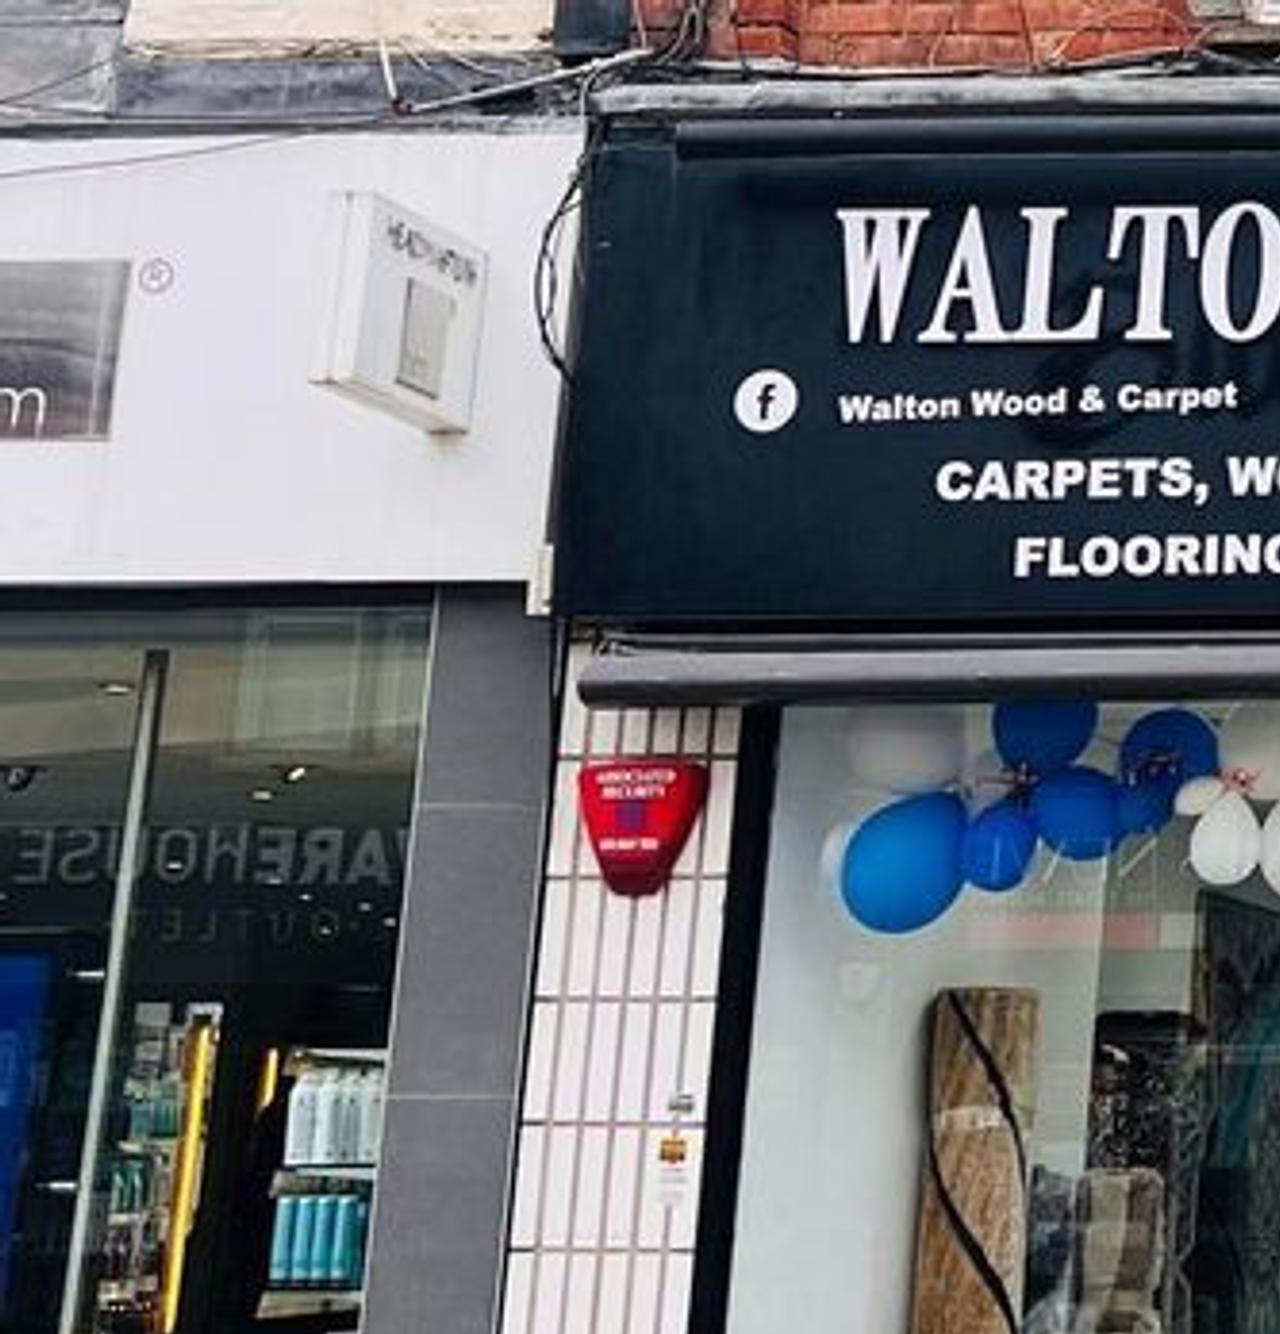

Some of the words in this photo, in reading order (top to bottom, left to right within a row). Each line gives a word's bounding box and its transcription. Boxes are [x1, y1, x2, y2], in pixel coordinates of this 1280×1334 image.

[838, 393, 961, 423] Walton
[970, 386, 1068, 417] Wood
[1078, 384, 1106, 413] &
[1117, 381, 1238, 416] Carpet
[936, 456, 1209, 506] CARPETS,
